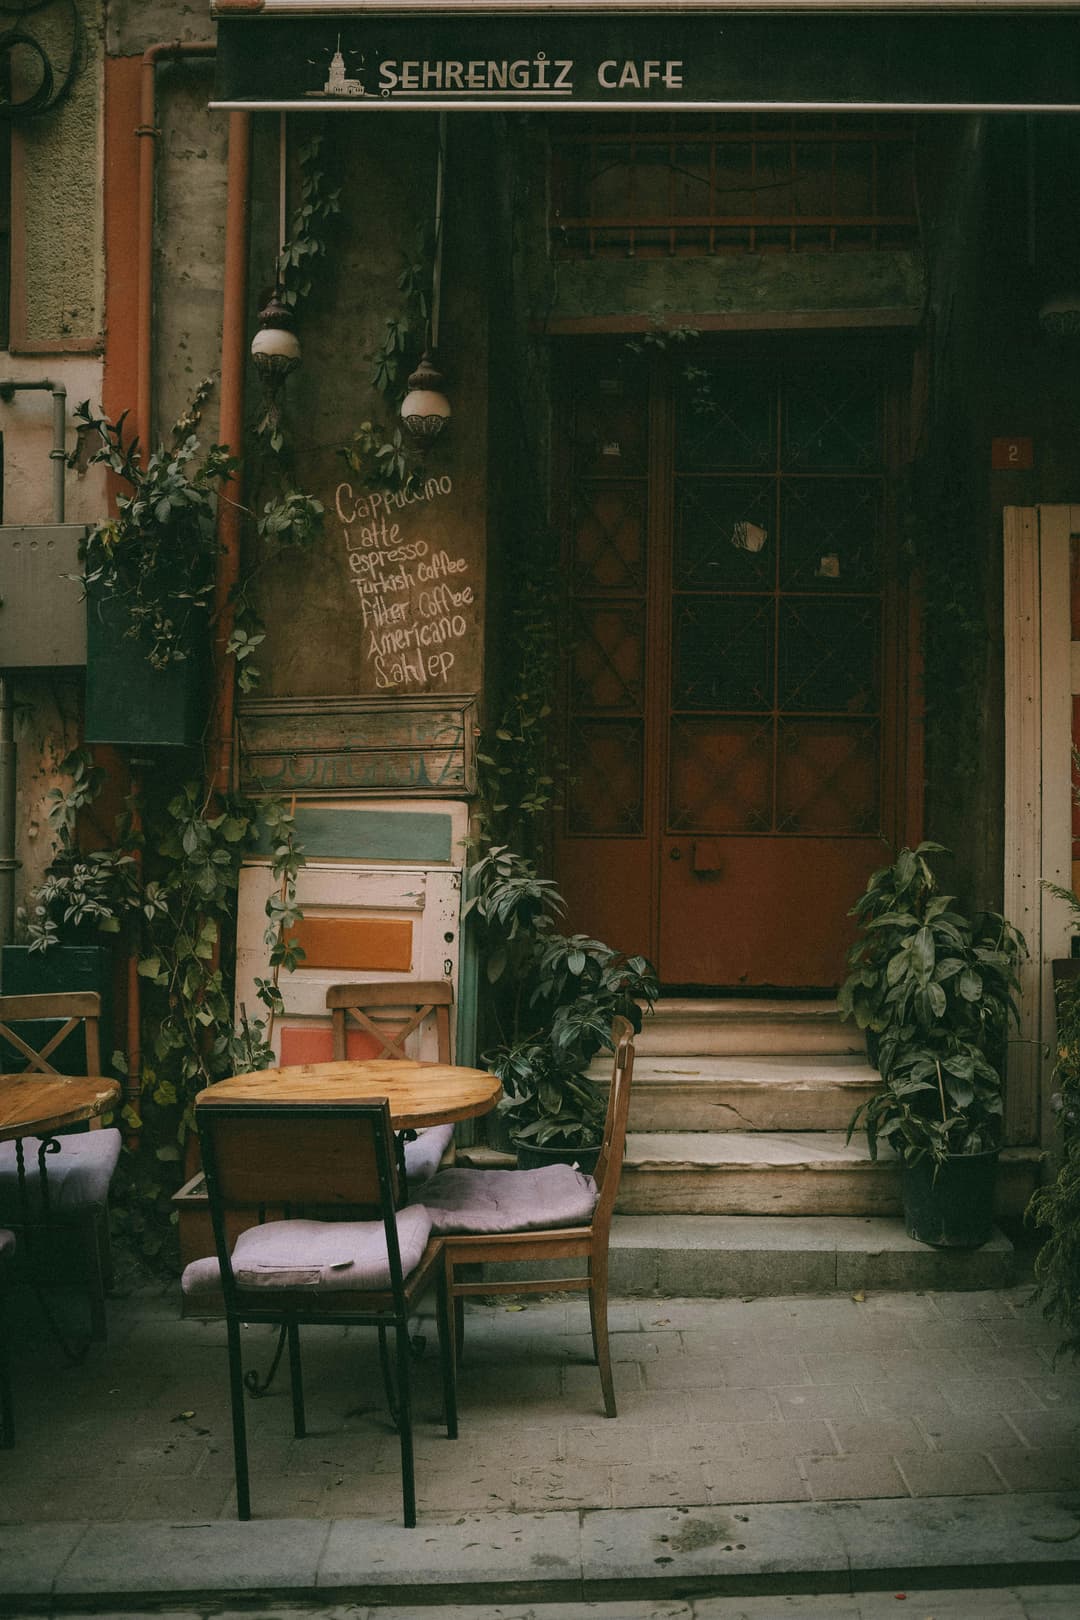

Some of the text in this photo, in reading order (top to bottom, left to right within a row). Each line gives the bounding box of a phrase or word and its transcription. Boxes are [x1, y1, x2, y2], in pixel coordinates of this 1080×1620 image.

[598, 60, 683, 89] CAFE
[1008, 445, 1019, 462] 2
[344, 515, 403, 551] Latte
[350, 564, 415, 598] Turkish
[419, 583, 474, 618] Coffee
[368, 615, 466, 660] Americano
[375, 648, 454, 688] Sahlep
